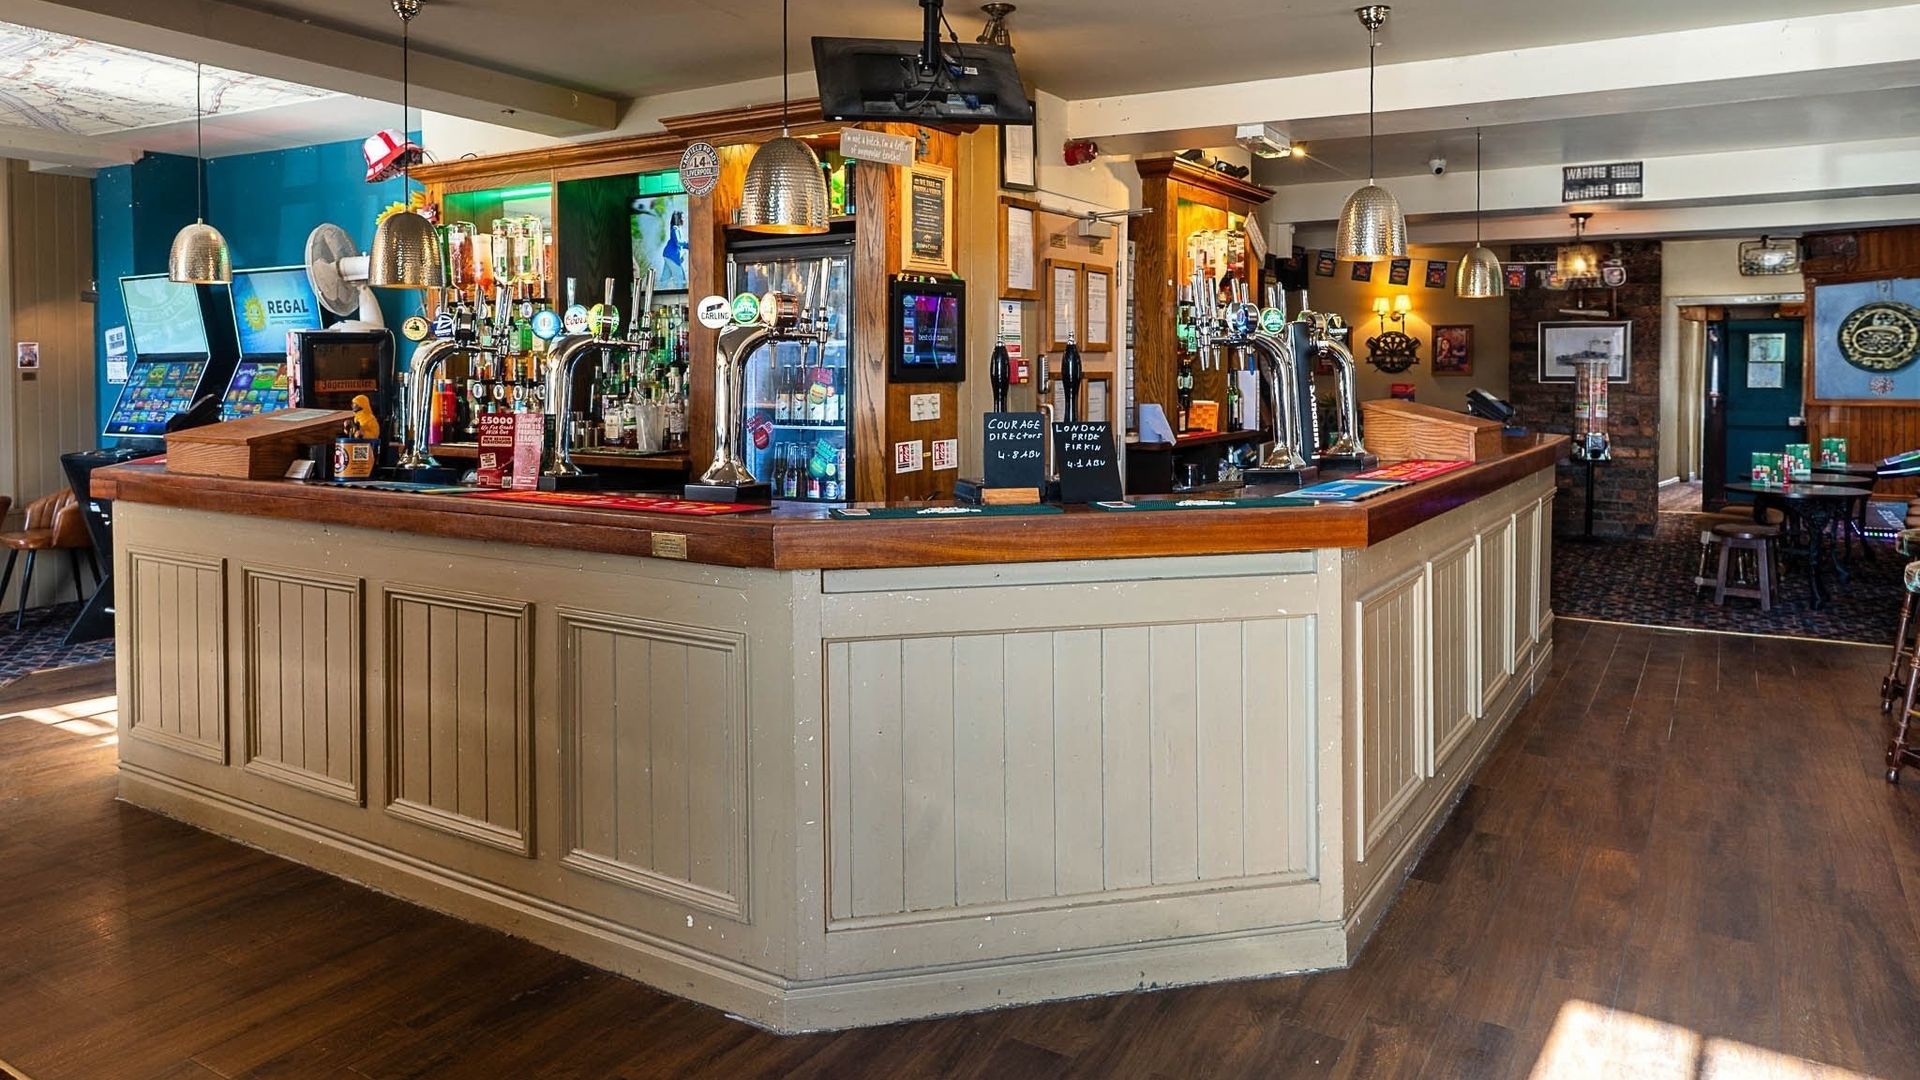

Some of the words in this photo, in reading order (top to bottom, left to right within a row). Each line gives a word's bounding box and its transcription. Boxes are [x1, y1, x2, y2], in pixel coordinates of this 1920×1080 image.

[683, 144, 703, 165] ANFIELD
[703, 145, 717, 162] ROAD
[686, 168, 713, 177] LIVERPOOL
[267, 299, 309, 314] REGAL
[701, 312, 730, 320] CARLING
[480, 416, 514, 425] £5000
[988, 418, 1040, 430] COURAGE
[1055, 424, 1106, 433] LONDON
[1071, 433, 1100, 441] PRIDE
[1064, 442, 1101, 451] FIRKIN
[997, 450, 1019, 459] 4.8
[1020, 450, 1041, 459] ABV
[1067, 460, 1083, 468] 4.1
[1085, 459, 1106, 467] ABV
